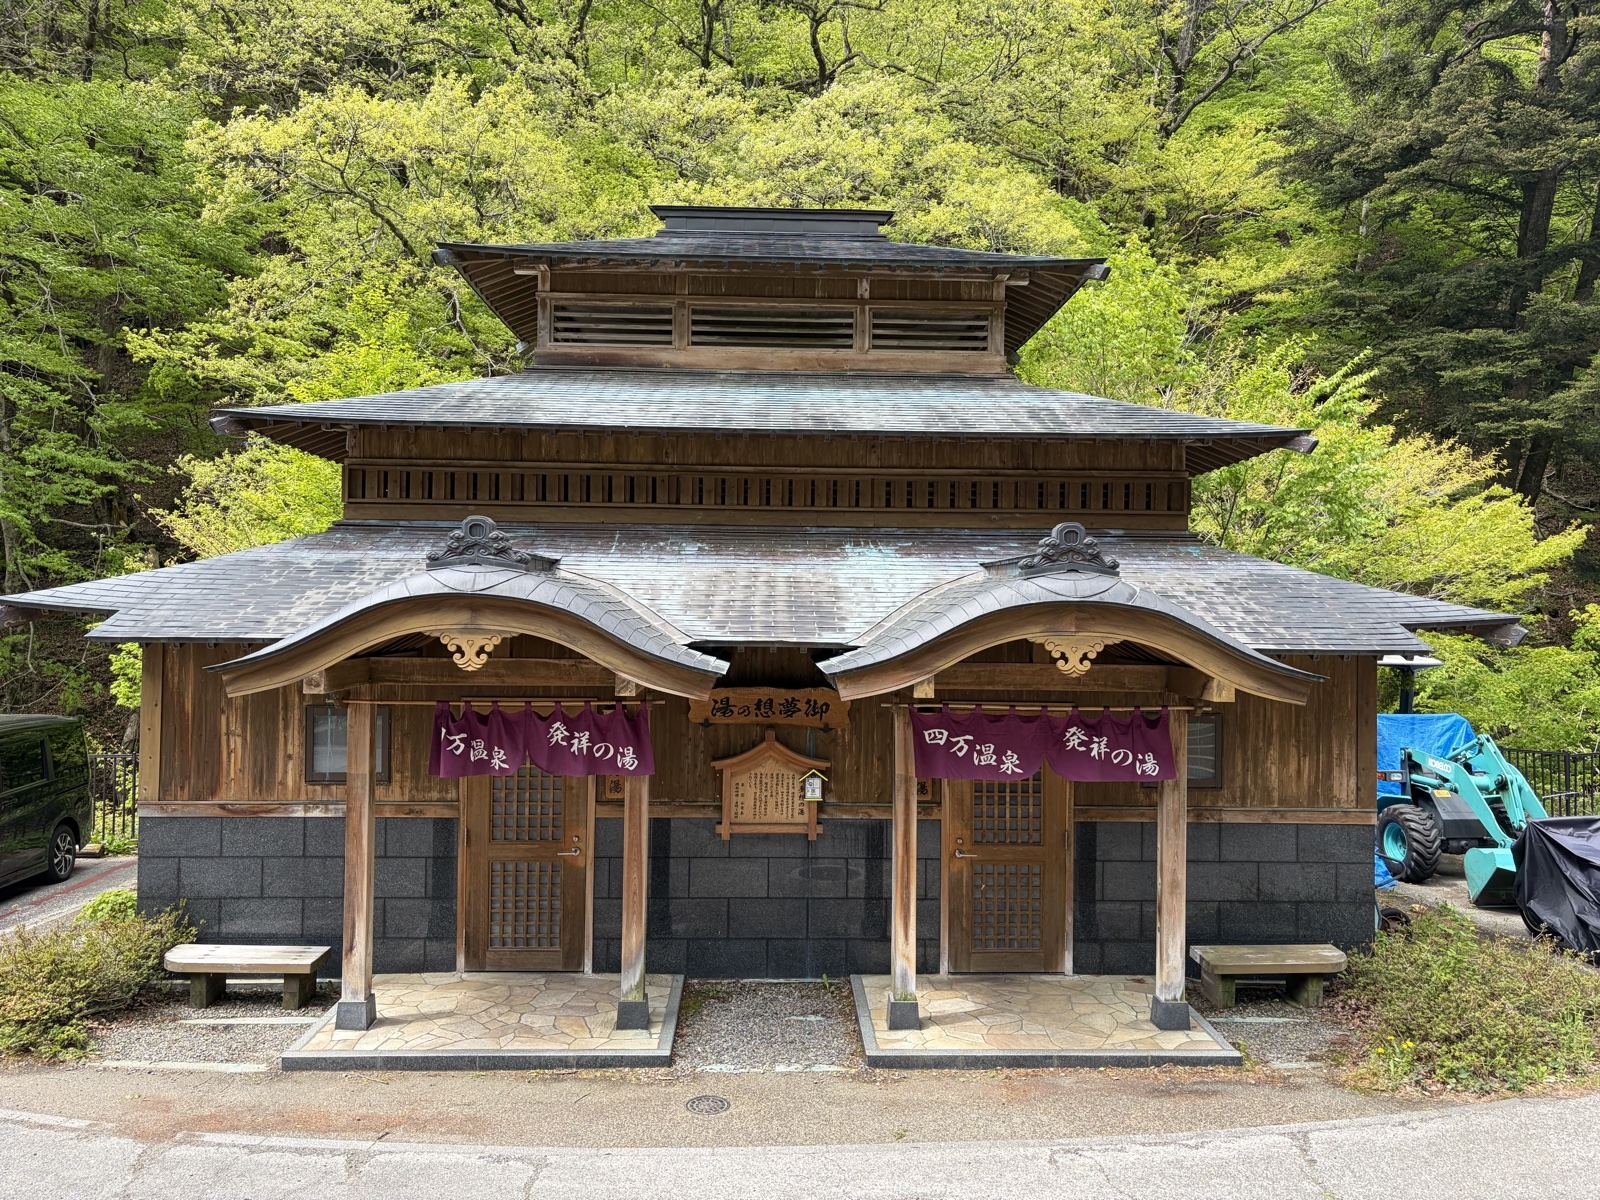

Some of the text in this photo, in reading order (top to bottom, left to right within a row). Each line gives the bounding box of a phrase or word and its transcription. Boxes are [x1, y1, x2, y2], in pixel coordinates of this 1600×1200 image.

[441, 721, 639, 771] 万温泉 発祥の湯
[923, 726, 1160, 777] 四万温泉 発祥の湯
